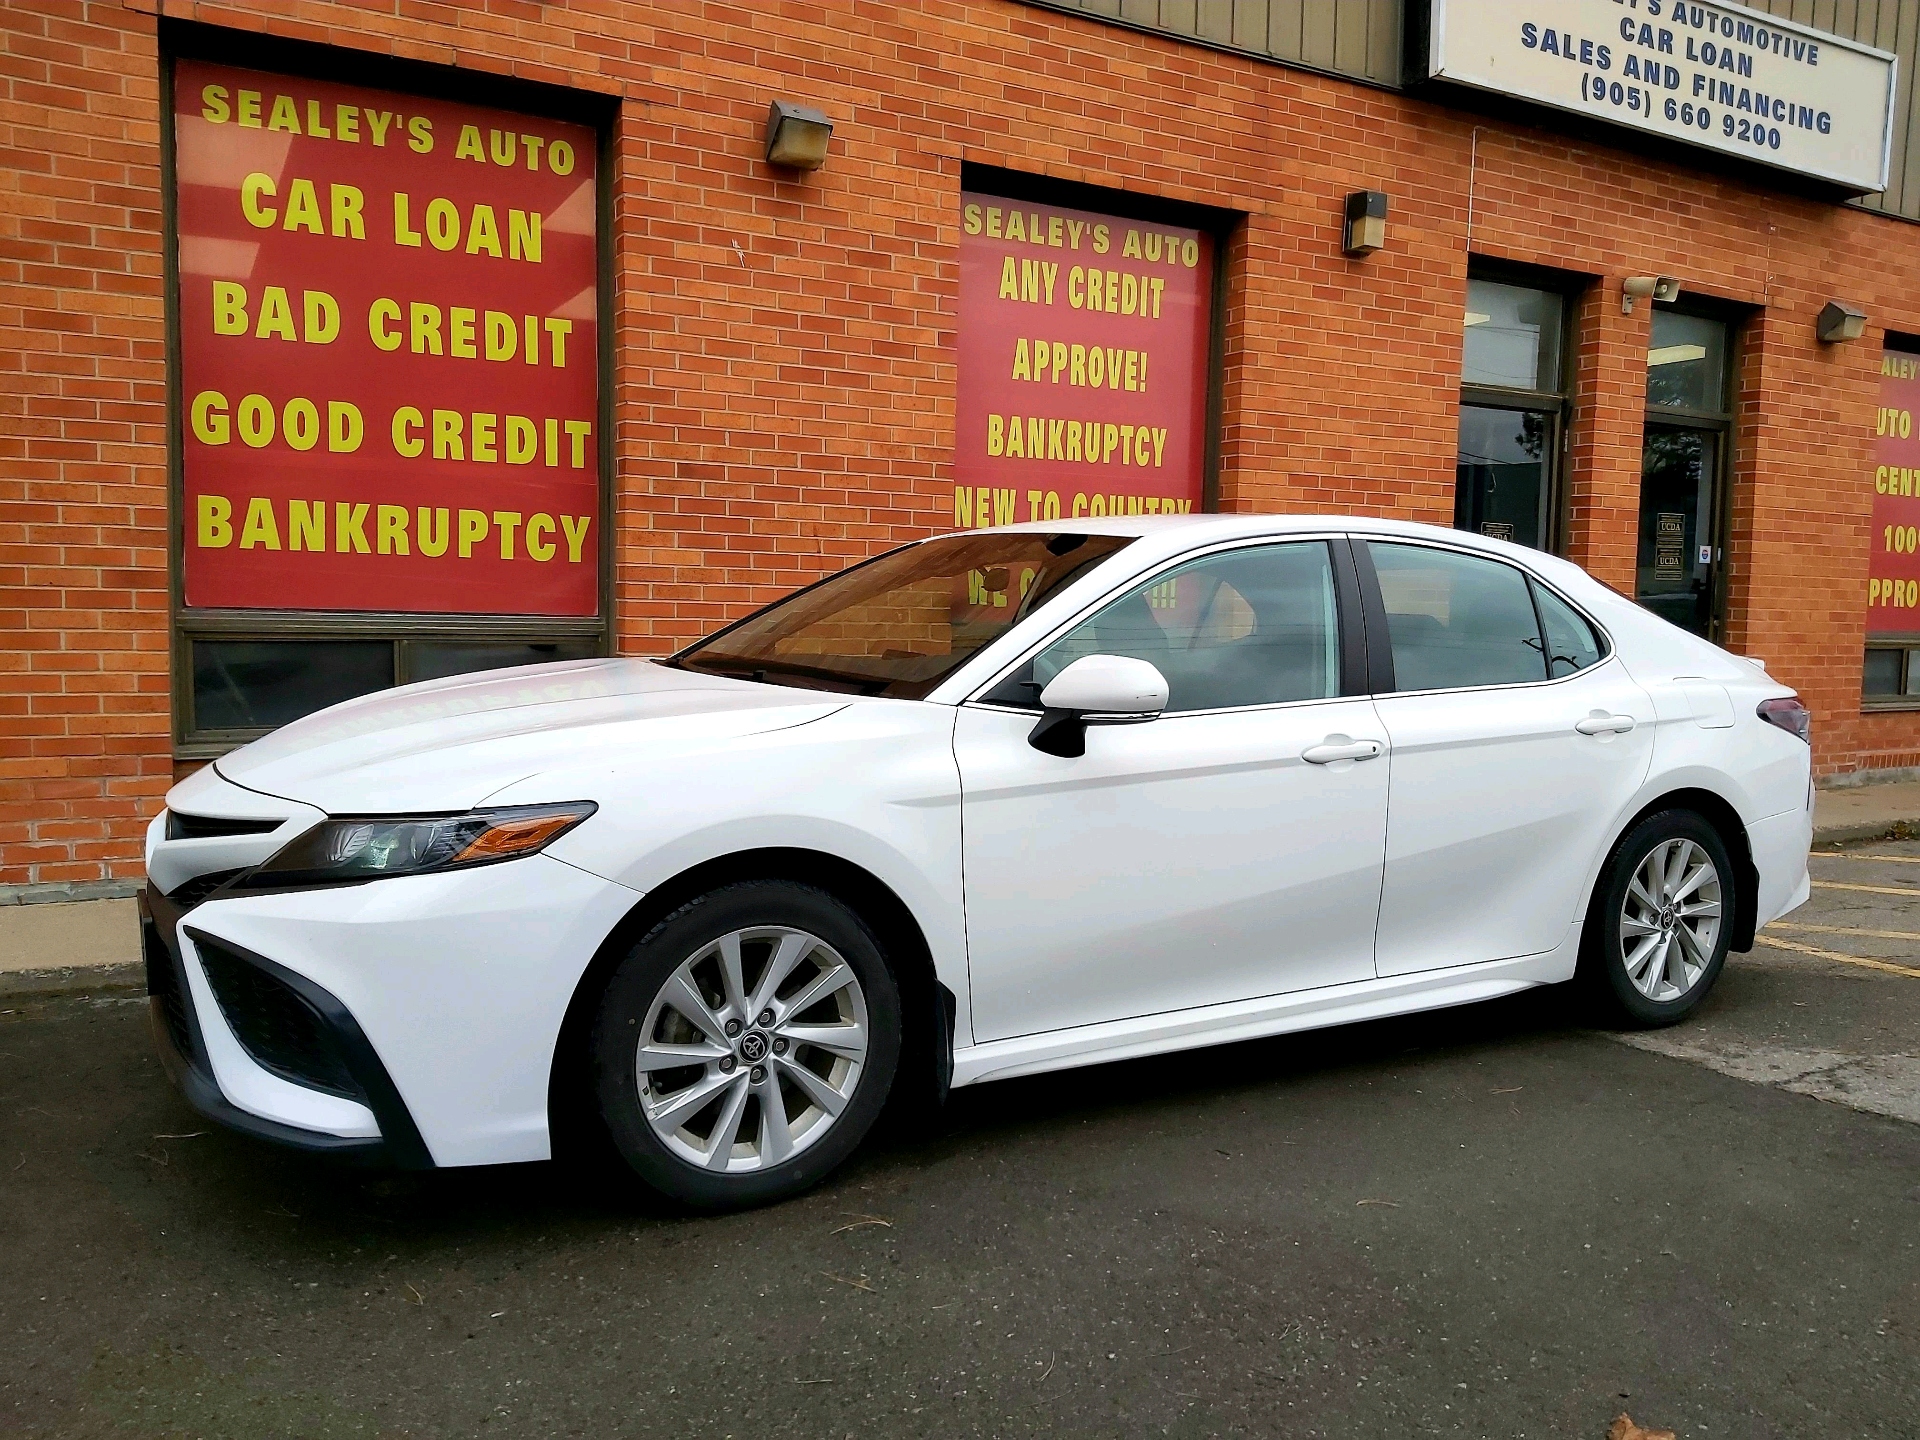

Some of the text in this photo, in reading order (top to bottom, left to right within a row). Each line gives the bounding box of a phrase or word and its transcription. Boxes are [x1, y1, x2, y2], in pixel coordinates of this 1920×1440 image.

[1620, 17, 1752, 78] CAR LOAN
[1672, 2, 1819, 66] AUTOMOTIVE
[1521, 22, 1832, 135] SALES AND FINANCING
[201, 84, 575, 176] SEALEY'S AUTO
[1581, 73, 1781, 150] (905) 660 9200
[241, 172, 542, 263] CAR LOAN
[963, 203, 1199, 268] SEALEY'S AUTO
[998, 256, 1165, 319] ANY CREDIT
[212, 280, 573, 367] BAD CREDIT
[1011, 338, 1148, 393] APPROVE!
[191, 390, 592, 469] GOOD CREDIT
[987, 414, 1168, 468] BANKRUPTCY
[197, 494, 592, 563] BANKRUPTCY
[954, 486, 1017, 528] NEW
[1027, 490, 1061, 522] TO
[1661, 522, 1680, 531] UCDA
[1884, 524, 1920, 554] 100
[1660, 557, 1679, 565] UCDA
